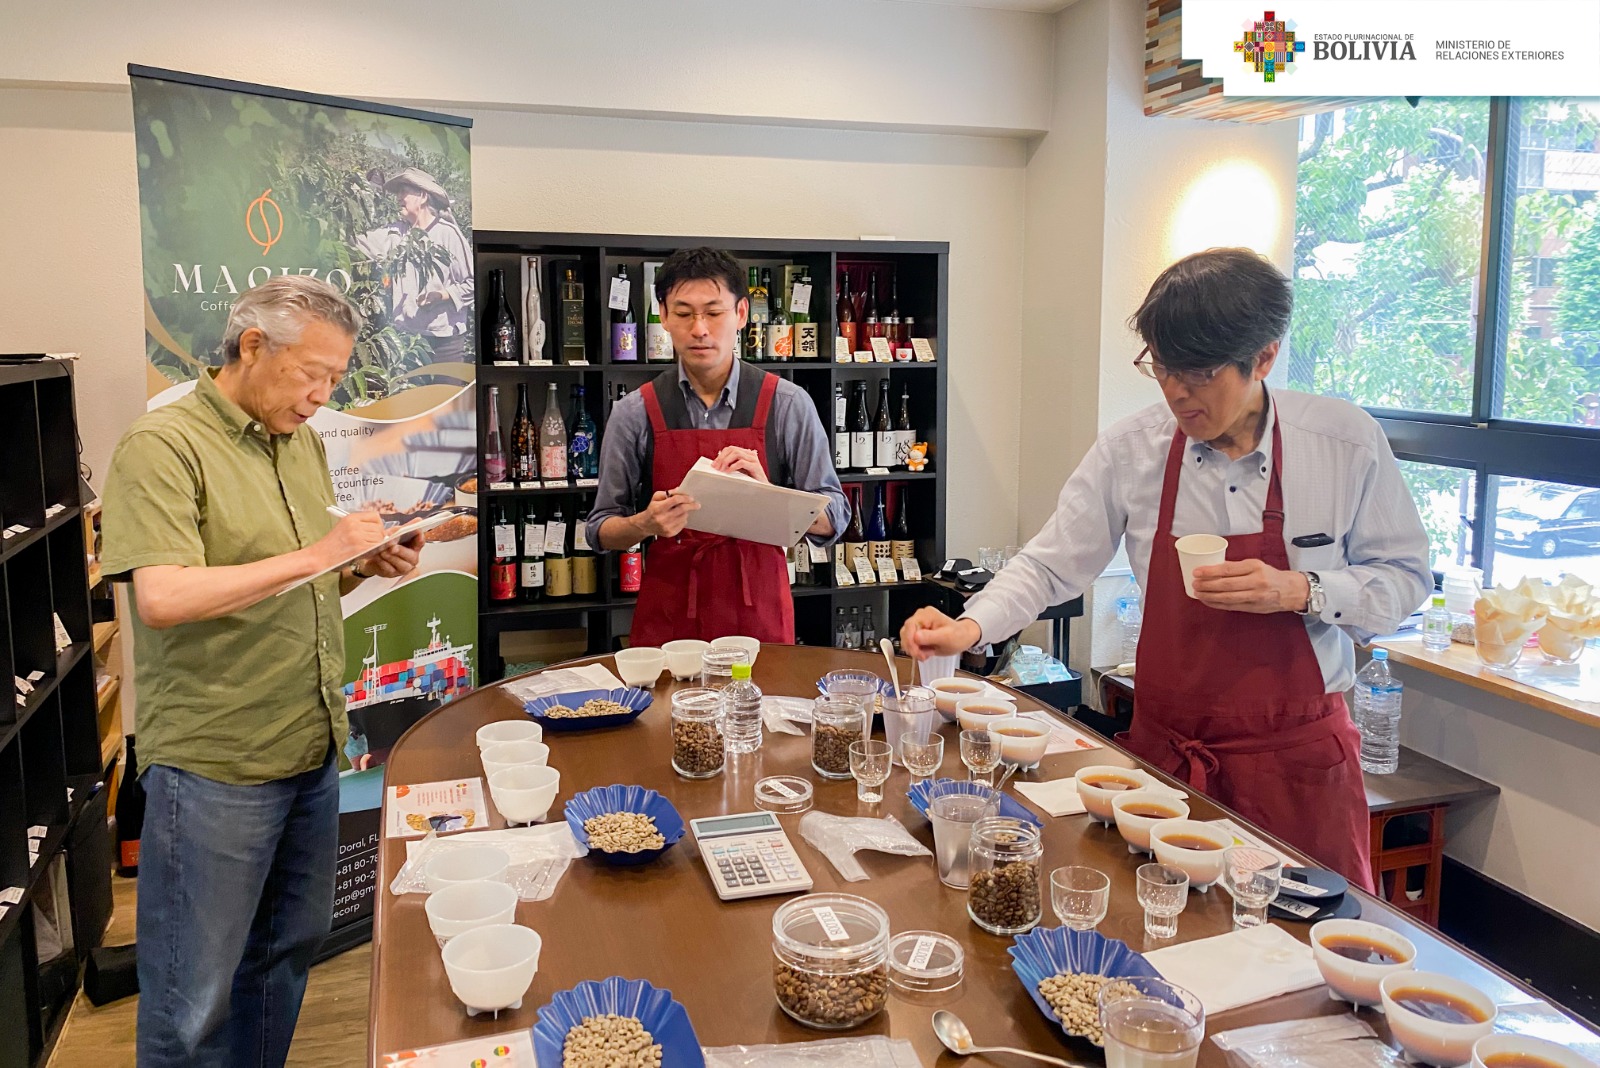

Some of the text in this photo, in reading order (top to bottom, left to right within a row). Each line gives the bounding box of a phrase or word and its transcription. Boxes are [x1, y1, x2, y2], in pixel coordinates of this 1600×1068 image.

[318, 426, 375, 439] and quality
[329, 466, 360, 477] coffee
[337, 476, 384, 489] countries
[339, 838, 366, 854] Doral,
[336, 863, 352, 876] +81
[336, 870, 377, 891] +81 90-2
[333, 885, 376, 906] orp@gm
